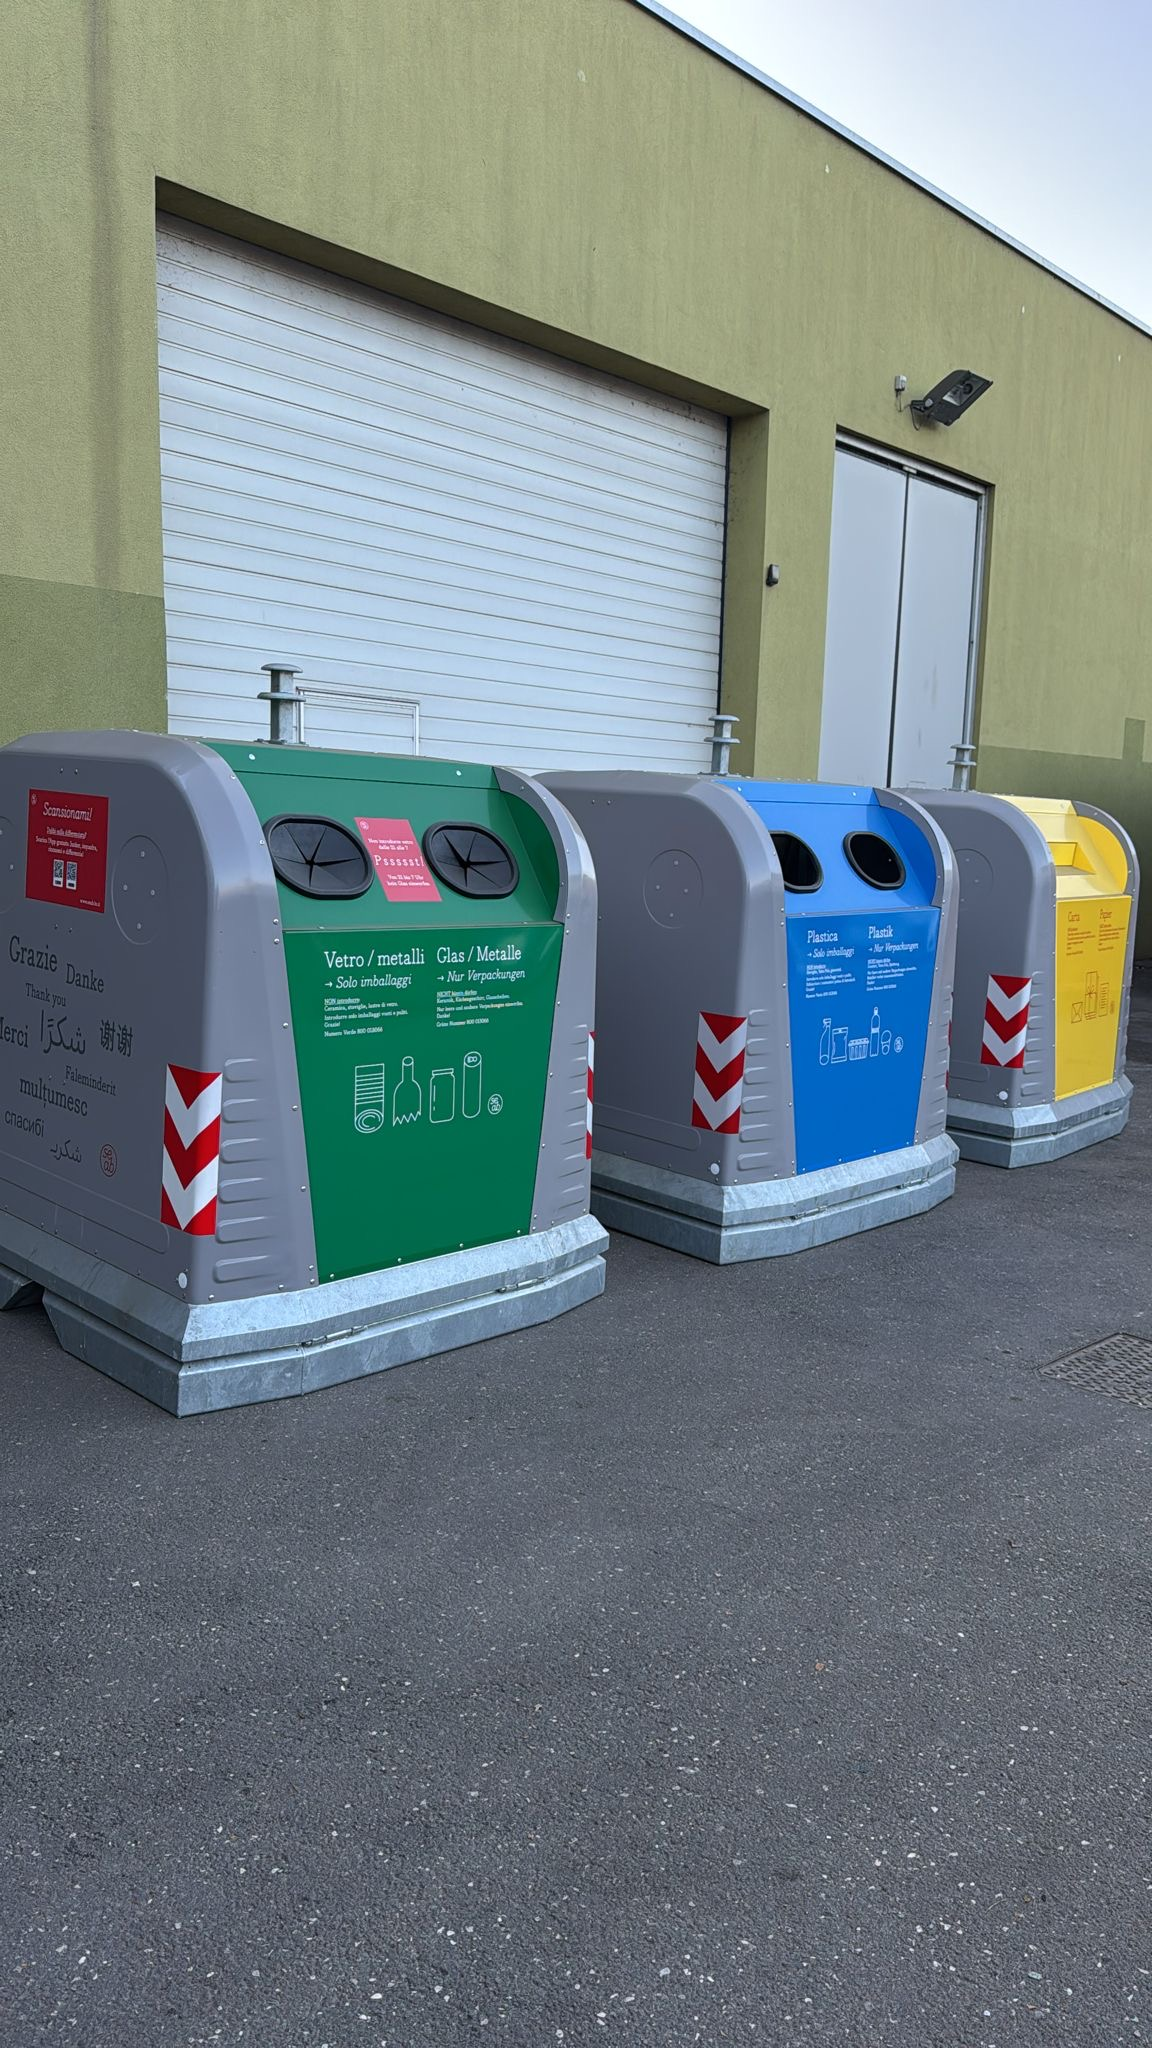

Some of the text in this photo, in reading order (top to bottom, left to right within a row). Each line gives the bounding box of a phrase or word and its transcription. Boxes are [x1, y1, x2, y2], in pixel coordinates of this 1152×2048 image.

[43, 802, 93, 822] Scansionami!
[807, 930, 838, 943] Plastica
[868, 925, 893, 939] Plastik
[324, 948, 425, 968] Vetro / metalli
[437, 945, 521, 963] Glas / Metalle
[813, 947, 855, 958] Solo imballaggi
[874, 942, 919, 954] Nur Verpackungen
[9, 935, 104, 993] Grazie Danke
[336, 974, 412, 989] Solo imballaggi
[447, 968, 525, 984] Nur Verpackungen
[25, 983, 66, 1009] Thank you
[99, 1019, 133, 1058] 谢谢
[65, 1065, 116, 1096] Faleminderit
[19, 1078, 88, 1117] mulțumesc
[4, 1110, 45, 1138] спасибі
